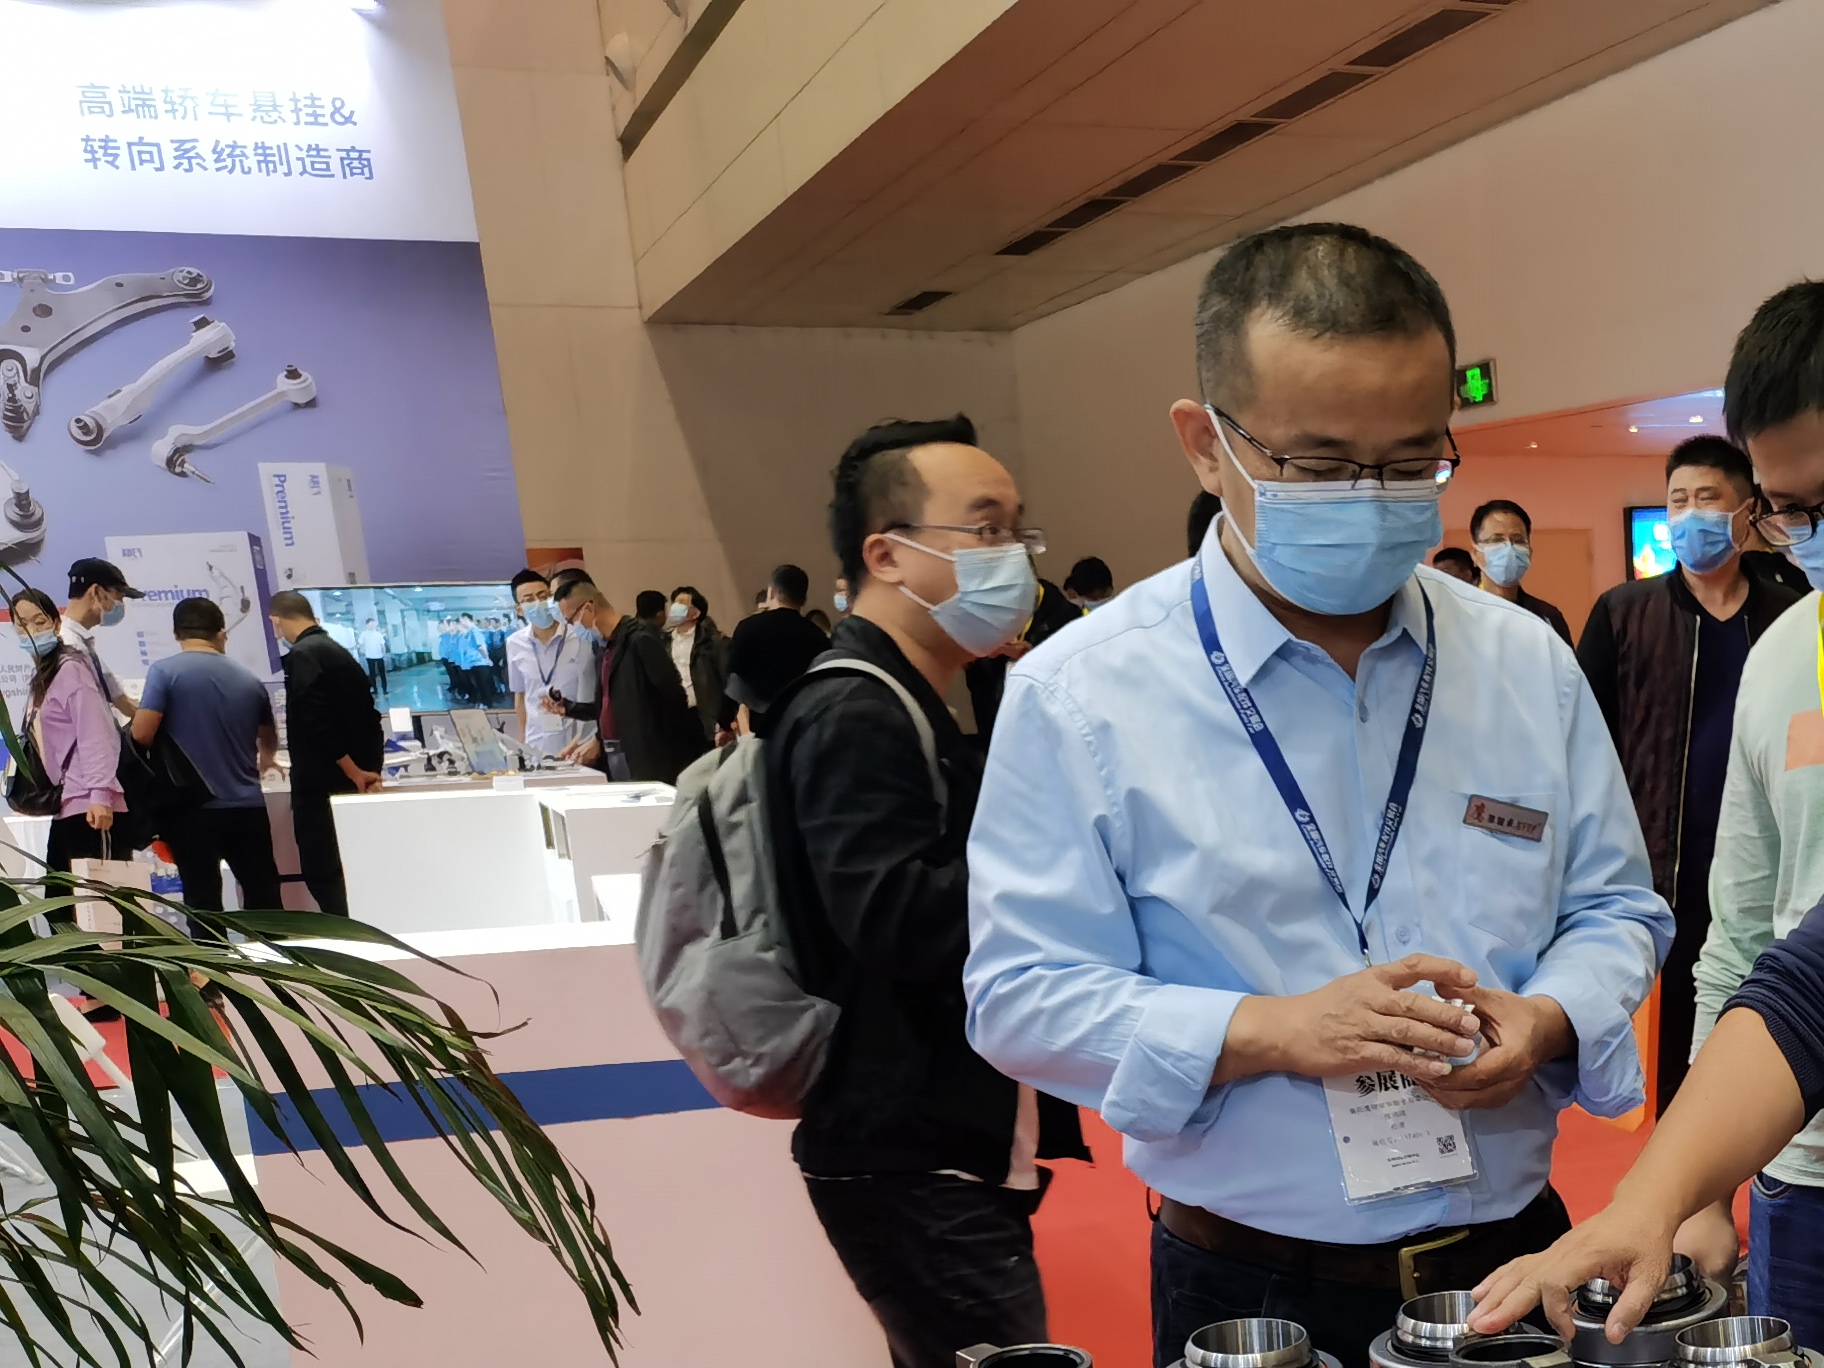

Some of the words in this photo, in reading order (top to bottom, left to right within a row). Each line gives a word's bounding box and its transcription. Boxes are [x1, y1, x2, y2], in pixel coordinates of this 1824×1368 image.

[75, 82, 357, 127] 高端轿车悬挂&
[81, 134, 374, 180] 转向系统制造商
[272, 473, 295, 548] Premium
[136, 584, 210, 602] remium
